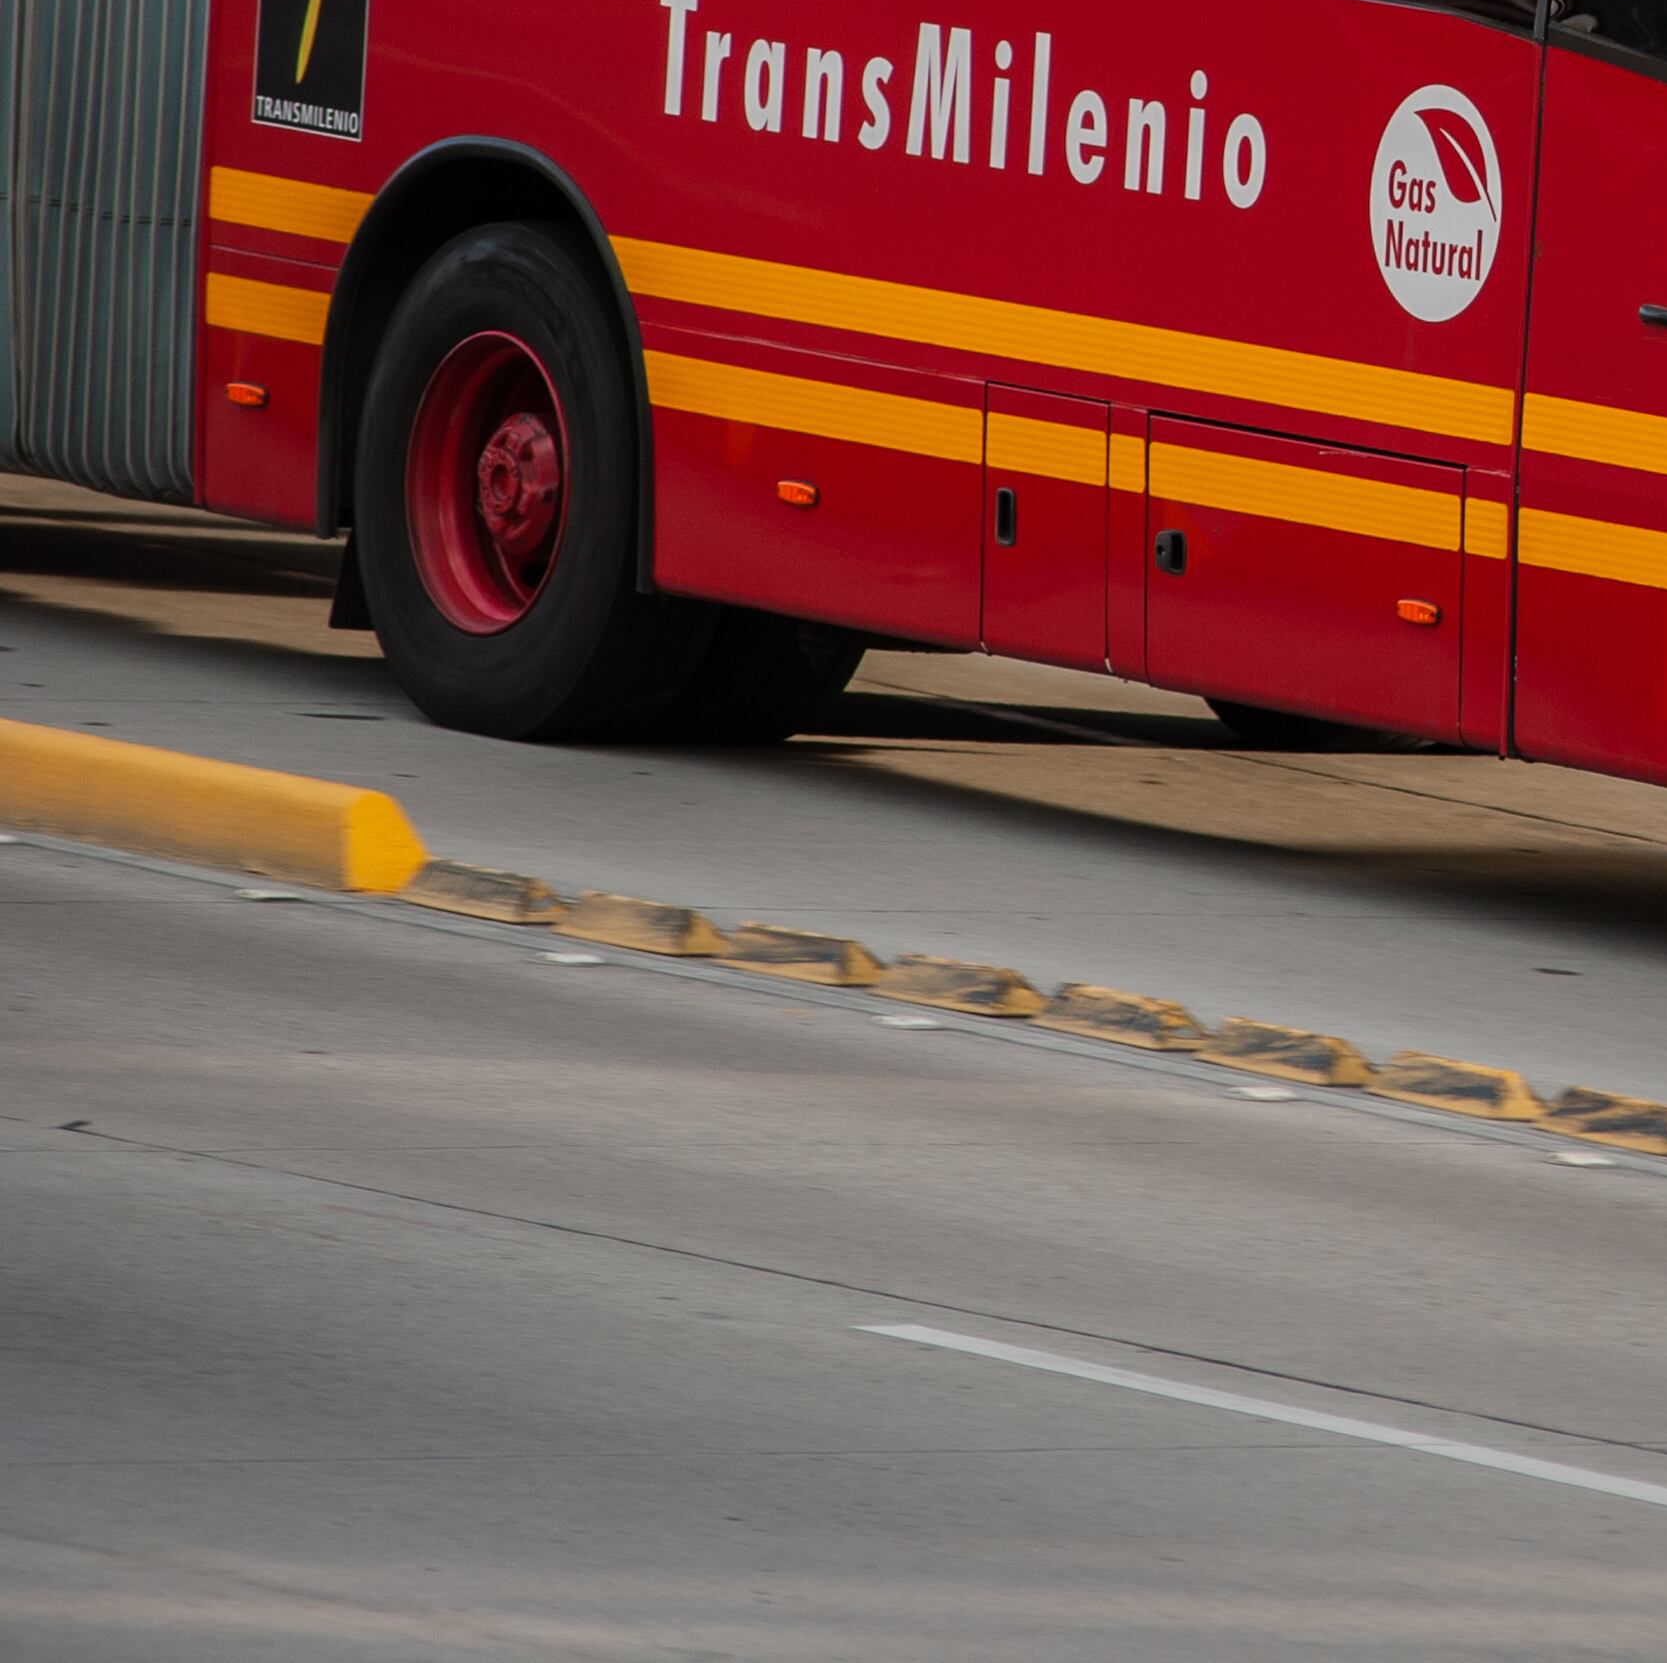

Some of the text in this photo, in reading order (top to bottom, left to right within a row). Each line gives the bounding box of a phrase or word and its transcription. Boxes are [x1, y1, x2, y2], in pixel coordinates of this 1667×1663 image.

[256, 96, 360, 134] TRANSMILENIO
[1389, 160, 1436, 214] Gas
[1385, 219, 1483, 281] Natural
